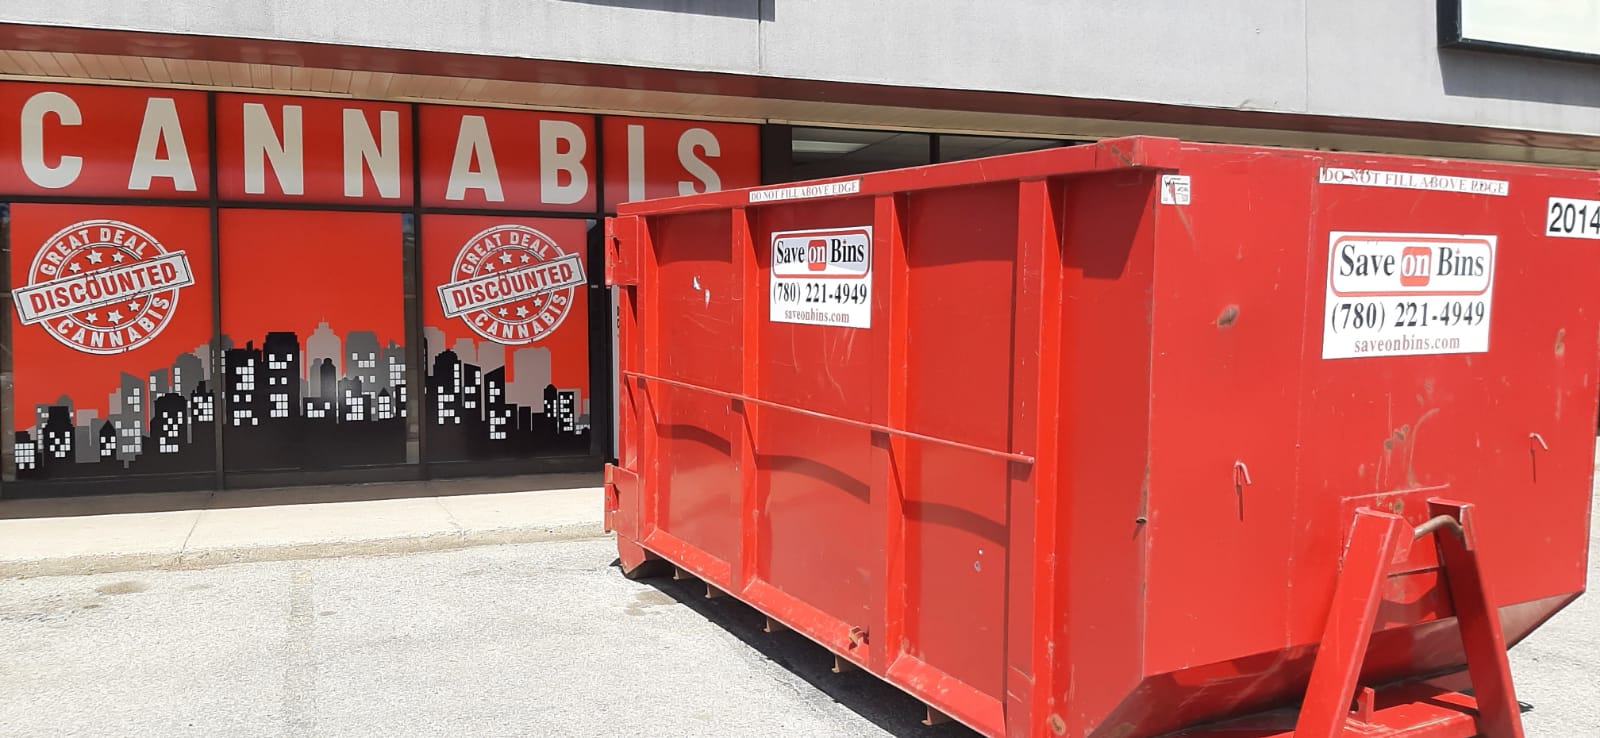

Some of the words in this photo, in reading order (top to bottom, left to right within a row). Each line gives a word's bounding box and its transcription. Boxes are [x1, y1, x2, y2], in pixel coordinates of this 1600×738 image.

[20, 91, 722, 204] CANNABIS
[751, 192, 762, 201] DO
[763, 190, 779, 200] NOT
[780, 188, 799, 199] FILL
[799, 184, 830, 197] ABOVE
[832, 181, 857, 193] EDGE
[1324, 169, 1345, 182] DO
[1351, 171, 1381, 184] NOT
[1385, 173, 1417, 187] FILL
[1420, 176, 1466, 191] ABOVE
[1471, 181, 1506, 194] EDGE
[40, 228, 91, 276] GREAT
[99, 227, 149, 256] DEAL
[461, 233, 503, 275] GREAT
[509, 231, 550, 257] DEAL
[776, 240, 805, 264] Save
[808, 245, 826, 264] on
[830, 238, 865, 263] Bins
[1339, 244, 1395, 277] Save
[1401, 252, 1430, 277] on
[1437, 246, 1485, 276] Bins
[28, 261, 178, 314] DISCOUNTED
[452, 262, 573, 309] DISCOUNTED
[773, 281, 801, 304] (780)
[805, 282, 868, 305] 221-4949
[57, 295, 170, 348] CANNABIS
[474, 293, 567, 339] CANNABIS
[784, 307, 850, 324] saveonbins.com
[1331, 302, 1386, 334] (780)
[1394, 301, 1486, 328] 221-4949
[1354, 334, 1461, 353] saveonbins.com
